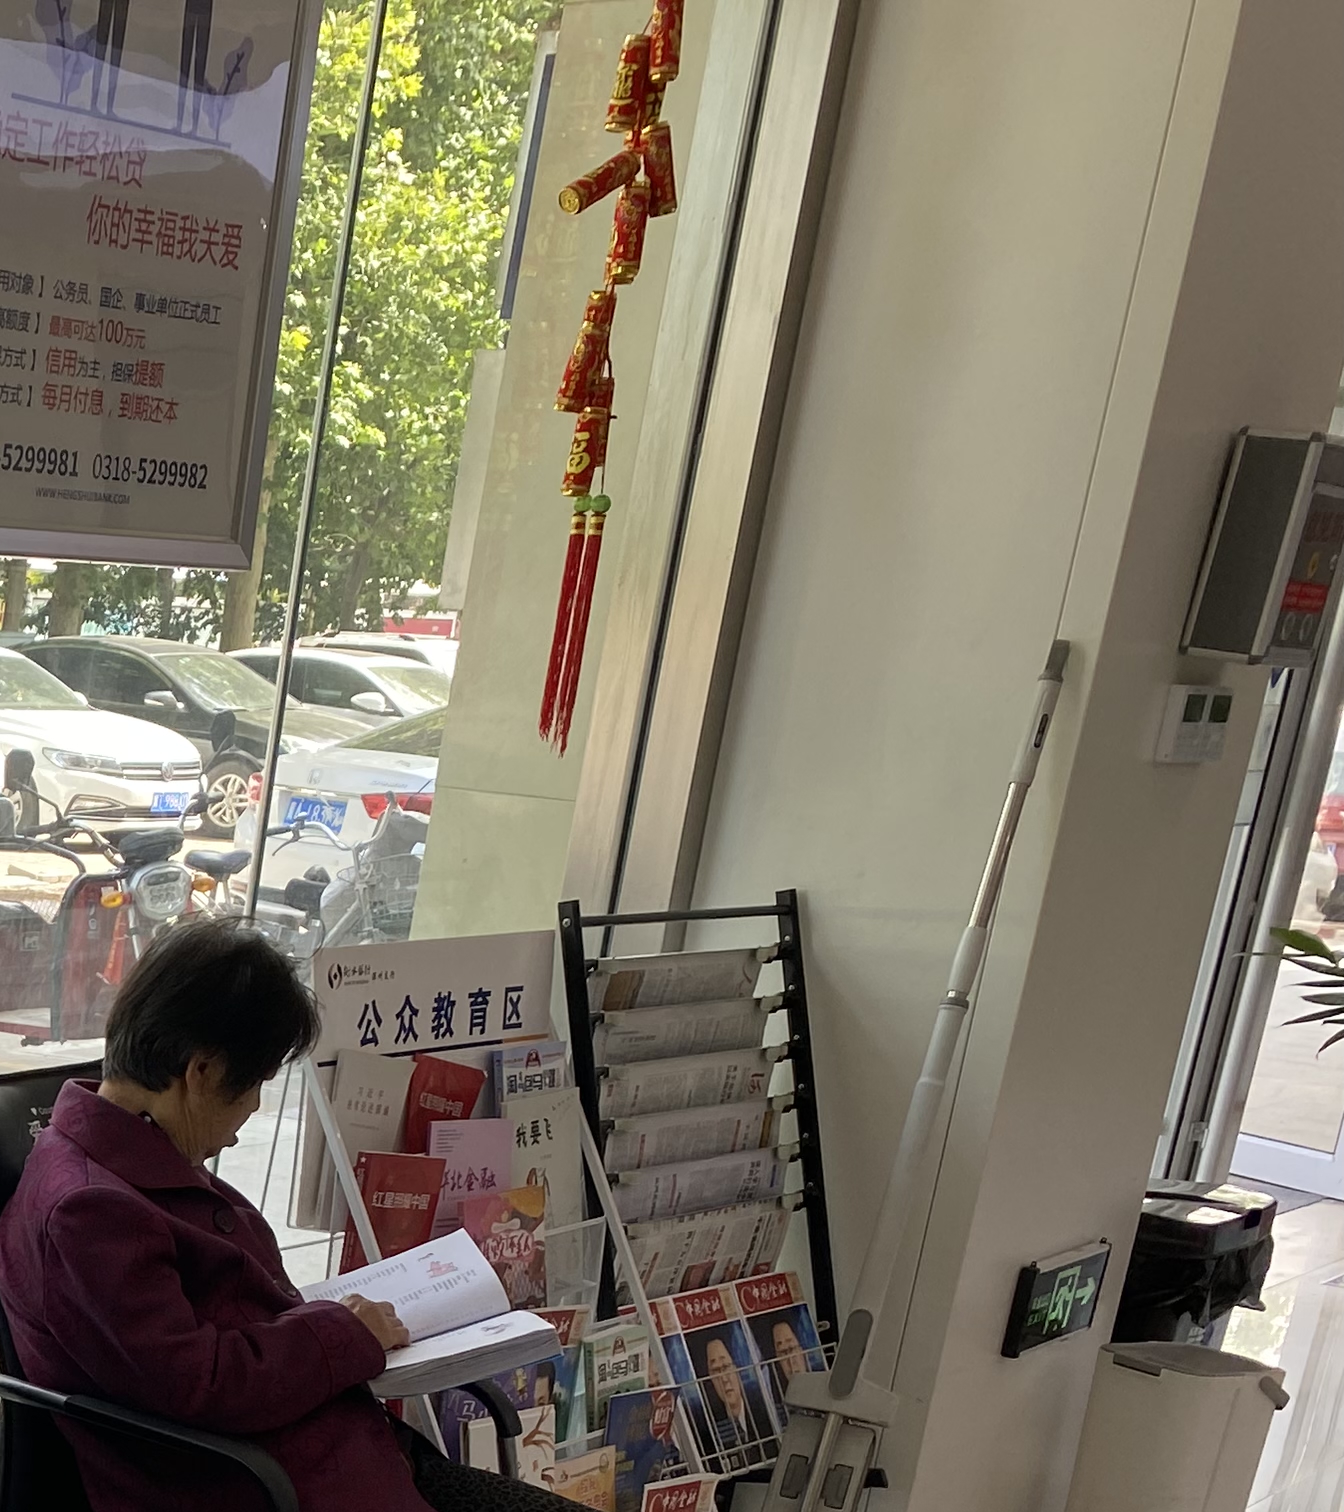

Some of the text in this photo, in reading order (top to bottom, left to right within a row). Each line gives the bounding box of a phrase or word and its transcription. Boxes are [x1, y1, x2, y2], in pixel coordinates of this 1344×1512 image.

[86, 195, 243, 271] 你的幸福我关爱
[92, 454, 208, 489] 0318-5299982
[357, 985, 525, 1048] 公众教育区
